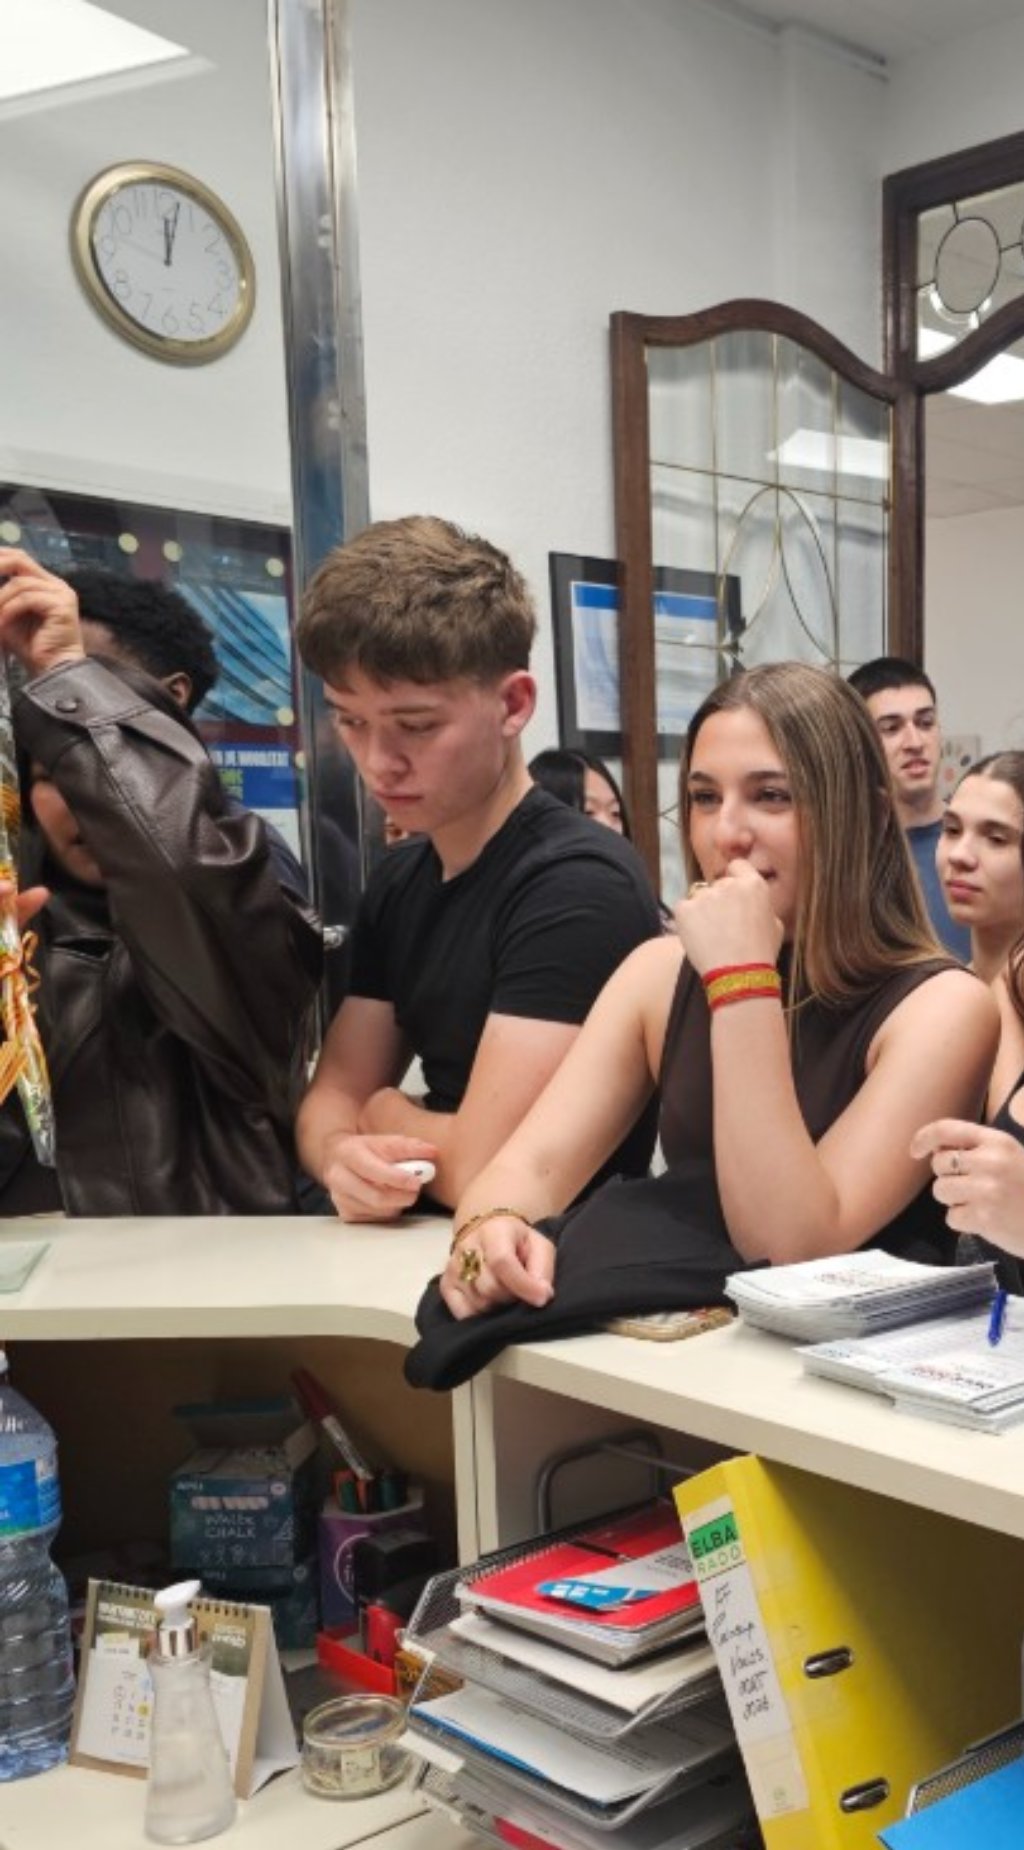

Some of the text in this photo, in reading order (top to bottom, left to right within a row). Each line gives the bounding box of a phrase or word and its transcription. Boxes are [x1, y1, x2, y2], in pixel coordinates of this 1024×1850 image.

[109, 205, 133, 236] 10
[133, 188, 148, 222] 11
[154, 188, 177, 223] 12
[188, 203, 195, 233] 1
[101, 235, 117, 266] 9
[202, 222, 221, 256] 2
[113, 268, 132, 300] 8
[215, 259, 233, 291] 3
[140, 292, 154, 320] 7
[161, 304, 180, 334] 6
[187, 301, 206, 335] 5
[206, 292, 228, 320] 4
[690, 1524, 738, 1558] ELBA
